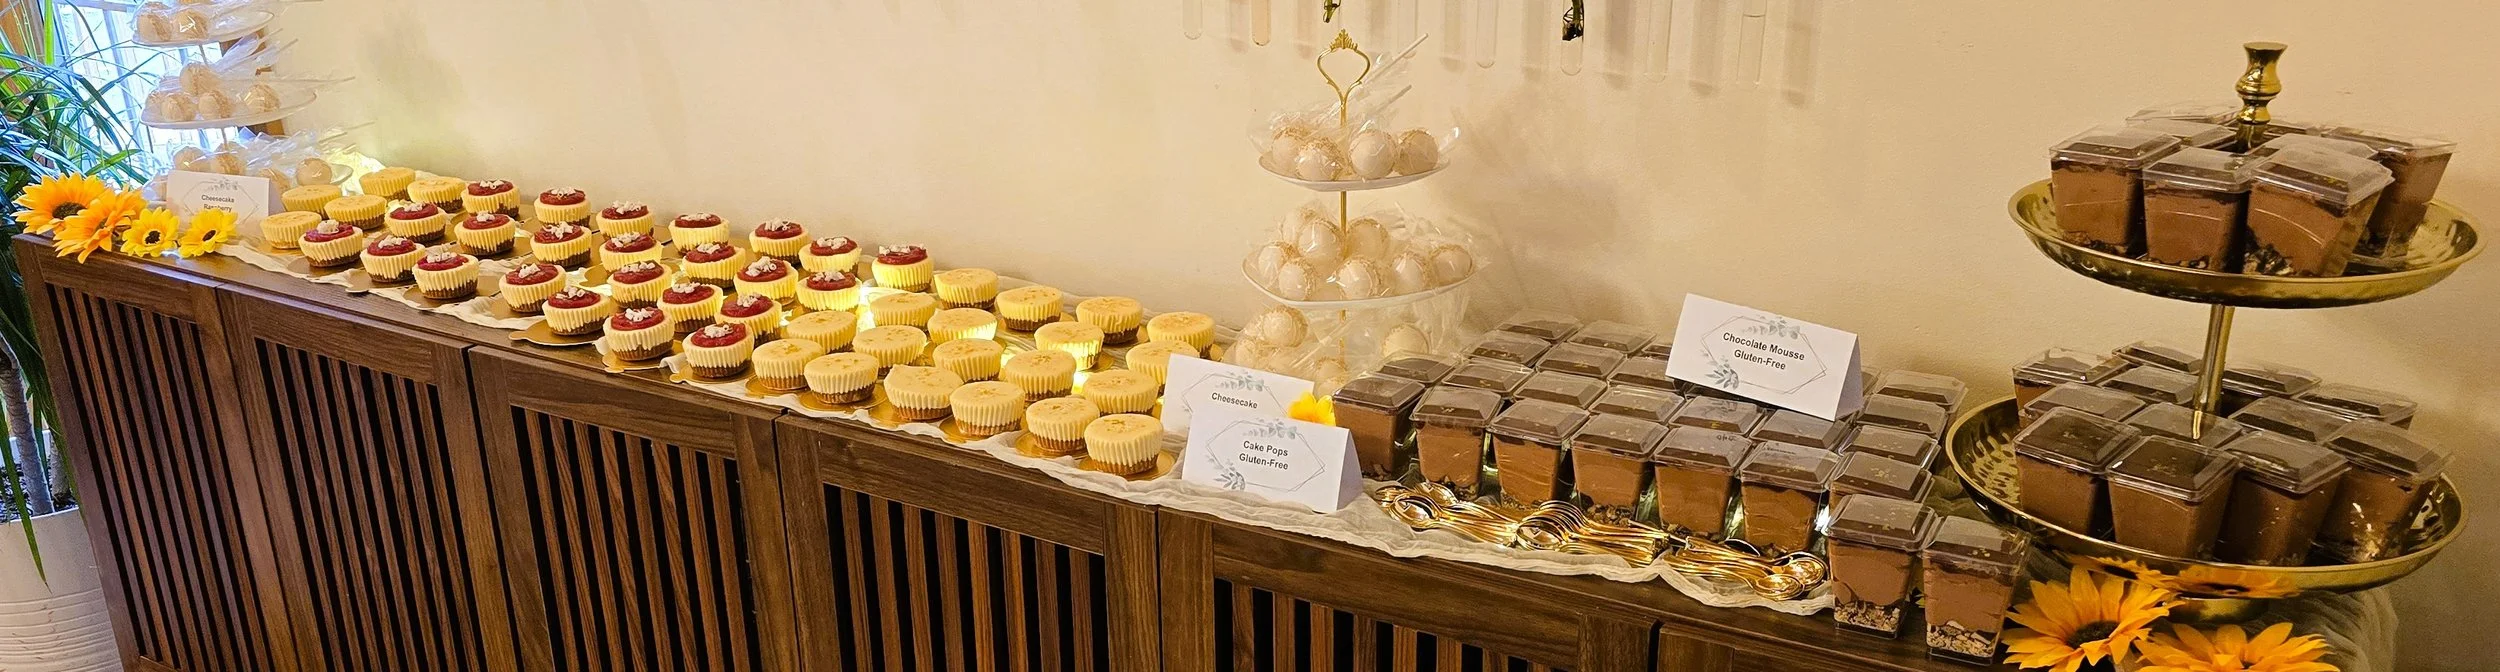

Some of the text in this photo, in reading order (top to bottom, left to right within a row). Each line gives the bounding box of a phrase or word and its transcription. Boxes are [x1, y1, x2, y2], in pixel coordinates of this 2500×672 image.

[201, 194, 235, 203] Cheesecake
[203, 203, 233, 213] Raberry
[1723, 332, 1805, 361] Chocolate Mousse
[1734, 349, 1786, 370] Gluten-Free
[1211, 392, 1258, 409] Cheesecake
[1243, 440, 1289, 457] Cake Pops
[1239, 452, 1289, 470] Gluten-Free
